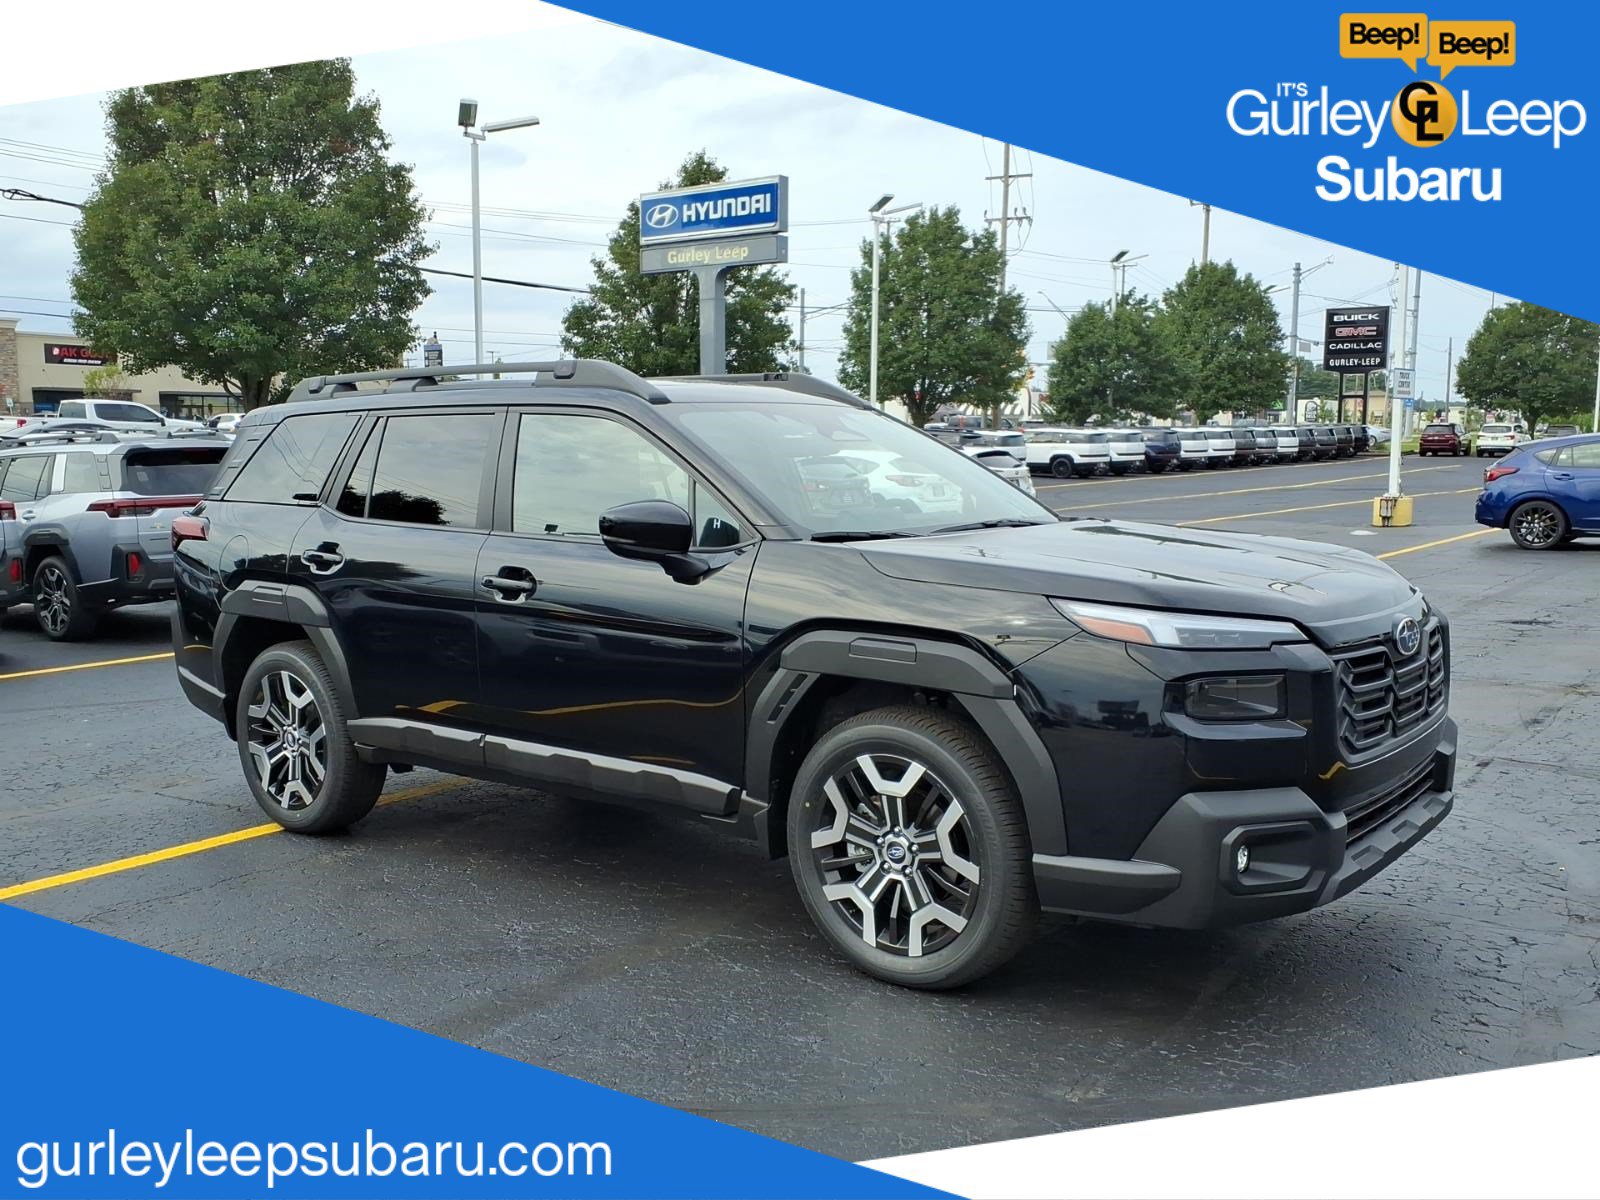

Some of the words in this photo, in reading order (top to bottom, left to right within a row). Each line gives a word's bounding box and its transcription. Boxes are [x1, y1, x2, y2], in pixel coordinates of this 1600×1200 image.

[682, 193, 771, 223] HYUNDAI
[667, 248, 711, 264] Gurley
[715, 246, 749, 261] Leep
[1333, 313, 1380, 322] BUICK
[1335, 326, 1377, 337] GMC
[1329, 342, 1382, 350] CADILLAC
[1329, 357, 1381, 367] GURLEY-LEEP
